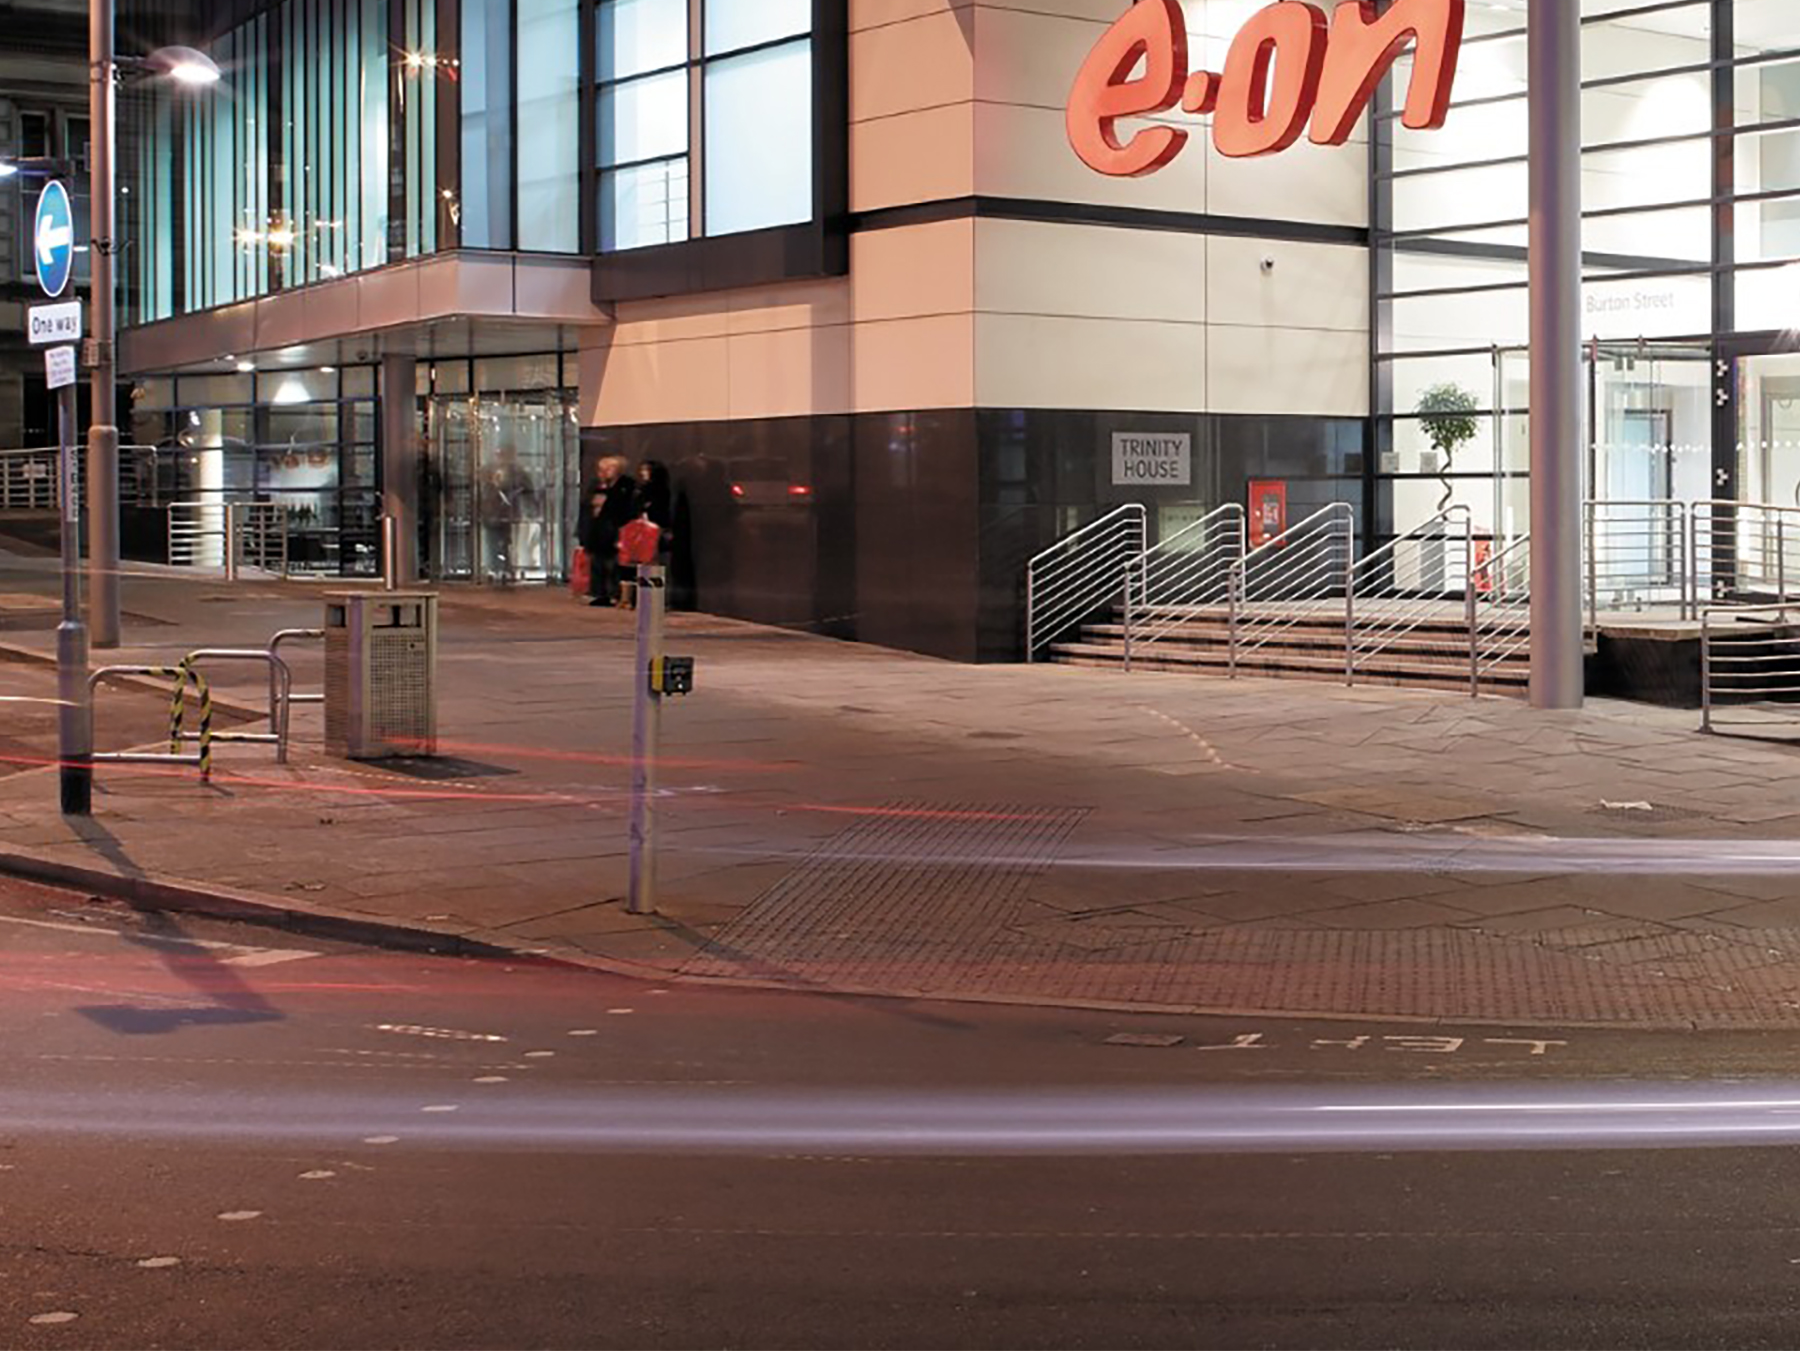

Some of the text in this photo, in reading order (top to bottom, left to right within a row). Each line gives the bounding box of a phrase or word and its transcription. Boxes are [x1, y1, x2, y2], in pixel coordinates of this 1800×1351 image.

[1586, 291, 1674, 314] Burton Street
[33, 315, 78, 334] One way
[1120, 438, 1182, 457] TRINITY
[1124, 459, 1179, 478] HOUSE
